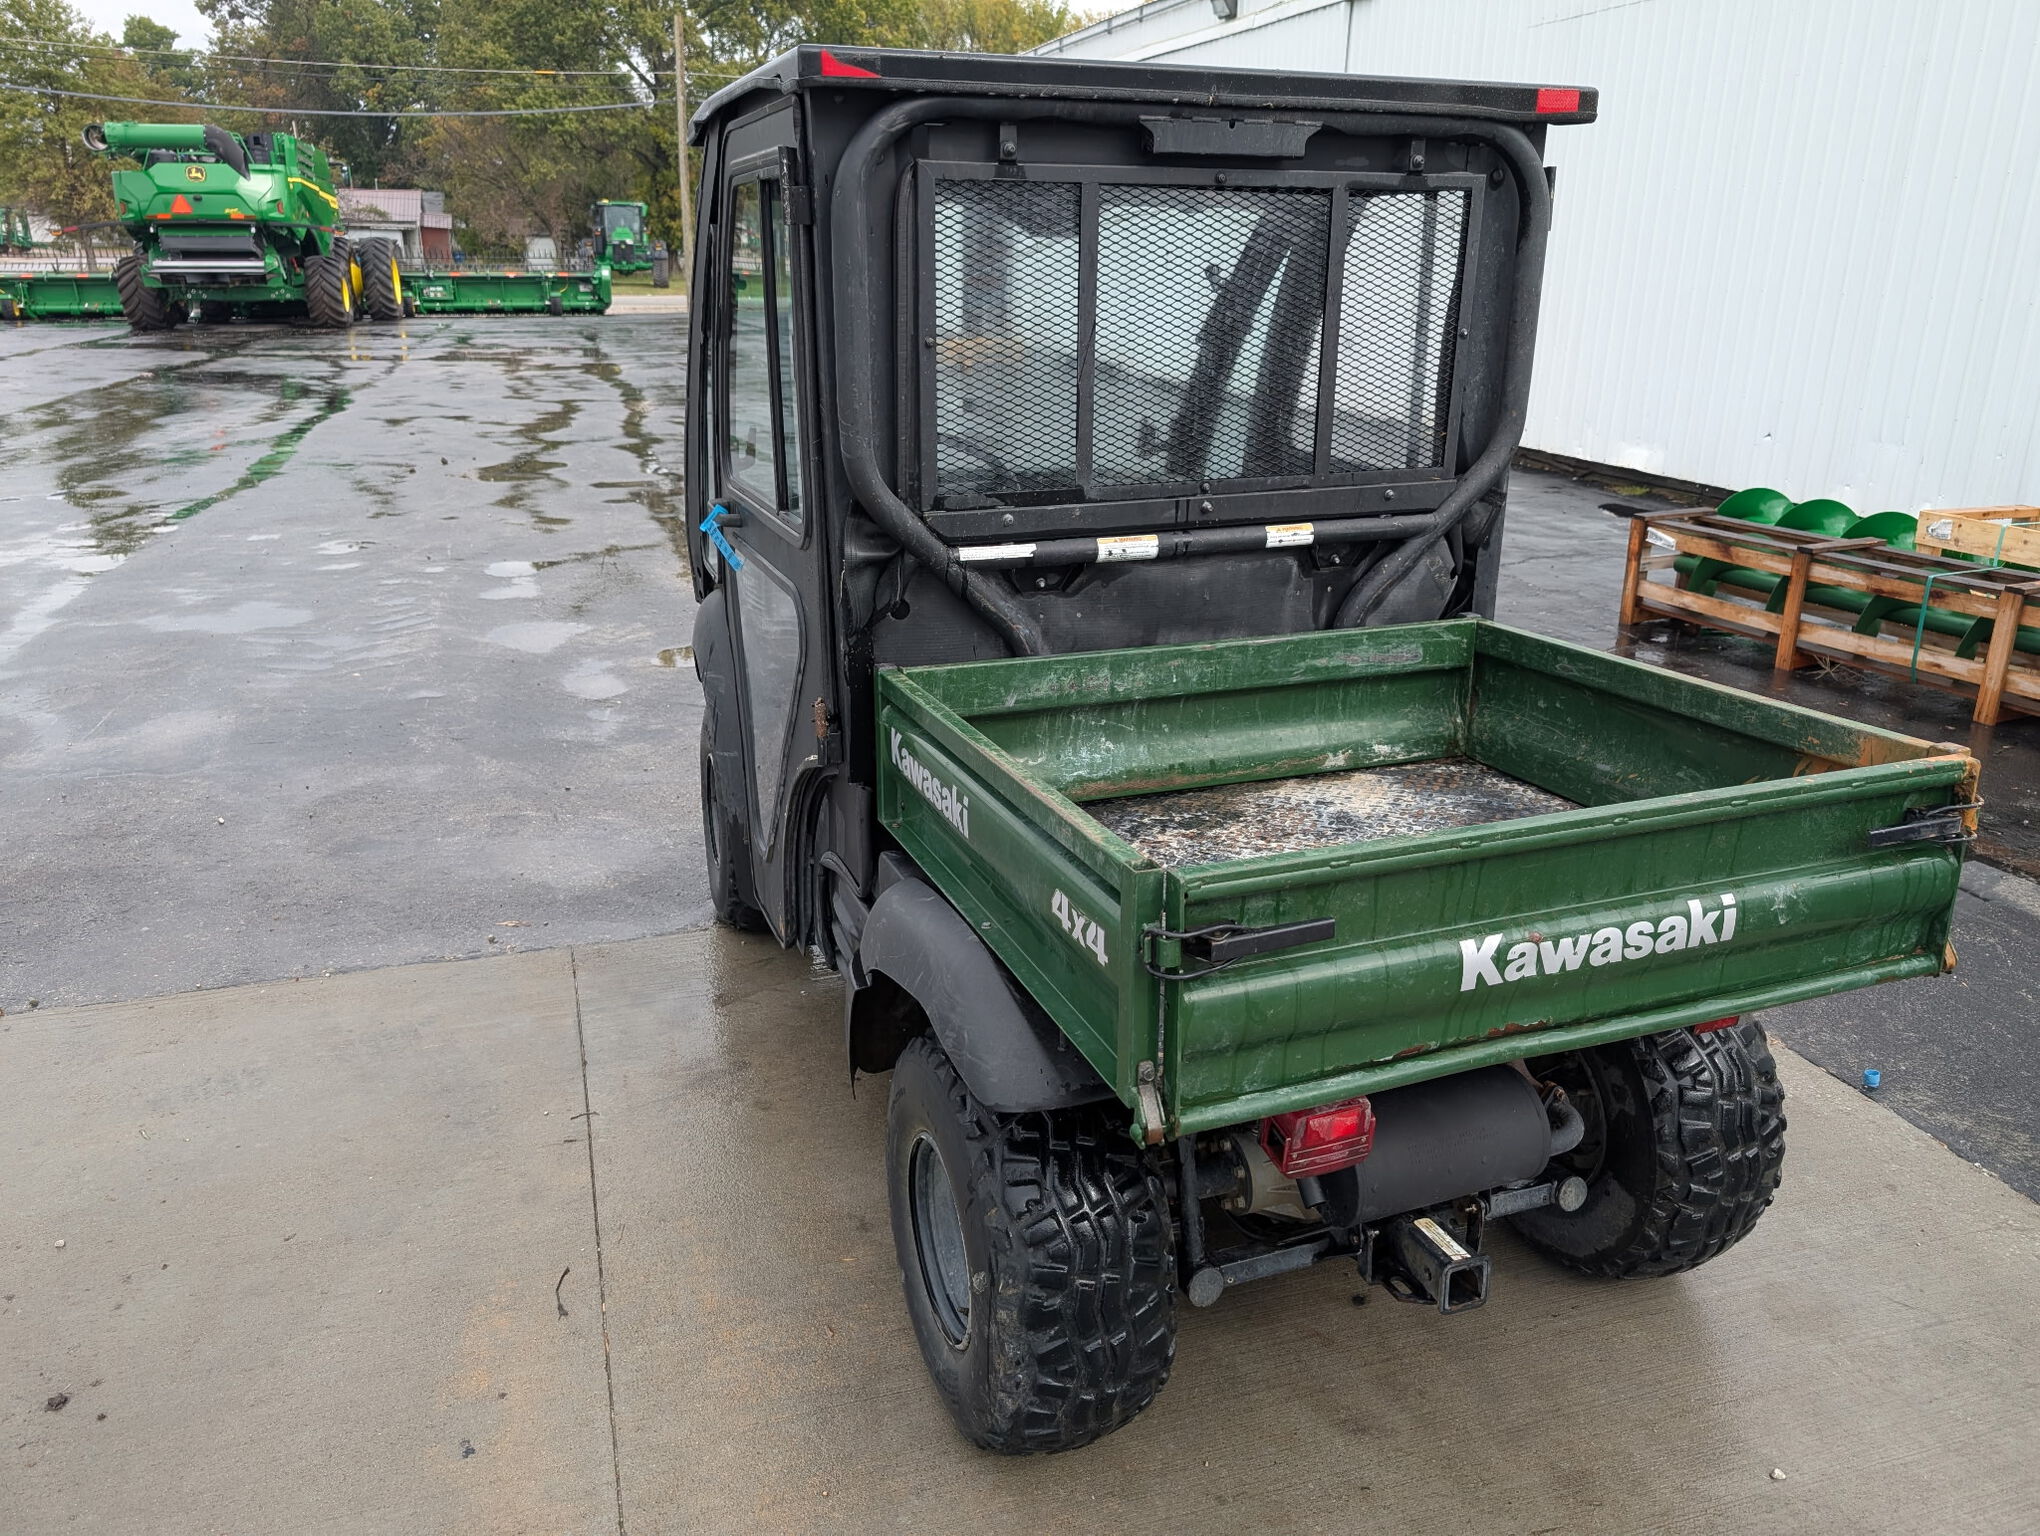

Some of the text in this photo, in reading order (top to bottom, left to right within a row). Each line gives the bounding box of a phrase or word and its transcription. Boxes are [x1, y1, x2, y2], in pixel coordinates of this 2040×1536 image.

[890, 727, 970, 839] Kawasaki
[1051, 888, 1109, 967] 4x4
[1458, 892, 1737, 992] Kawasaki
